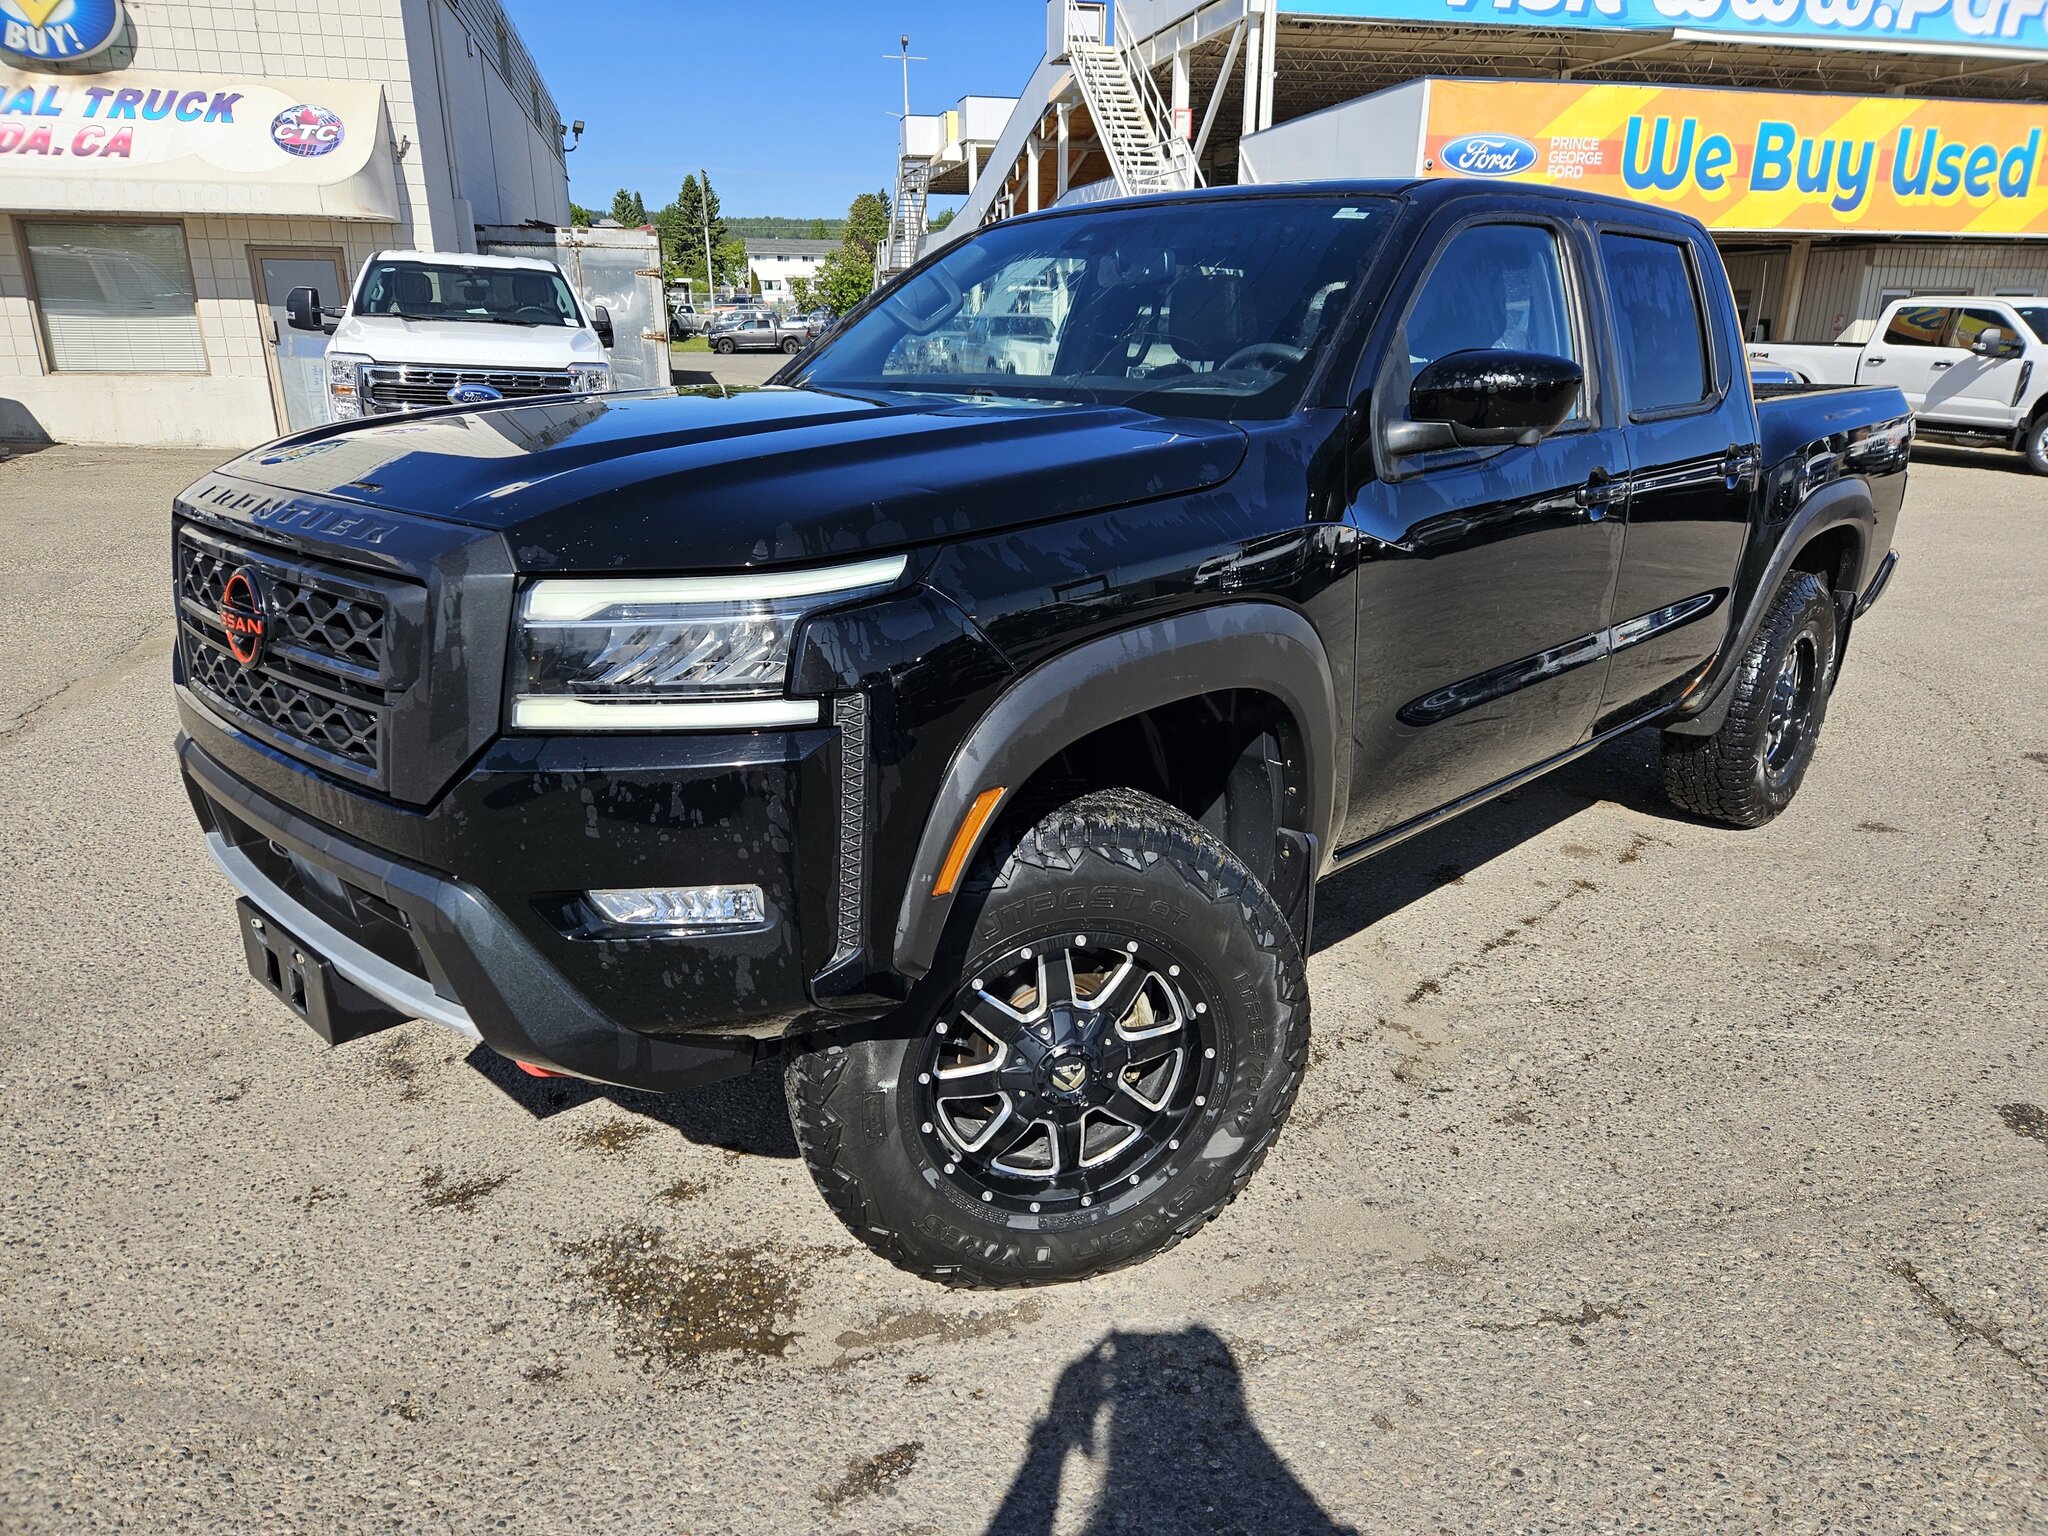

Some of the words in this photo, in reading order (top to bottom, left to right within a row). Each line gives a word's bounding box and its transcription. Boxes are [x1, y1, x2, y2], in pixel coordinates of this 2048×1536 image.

[4, 19, 85, 55] BUY!
[83, 87, 244, 123] TRUCK
[273, 123, 340, 144] CTC
[1550, 136, 1600, 150] PRINCE
[1458, 139, 1520, 170] Ford
[1548, 151, 1603, 164] GEORGE
[1619, 115, 1730, 192] We
[1748, 120, 1876, 211] Buy
[1891, 126, 2043, 198] Used
[1546, 164, 1584, 178] FORD
[198, 485, 400, 543] FRONTIER
[219, 610, 263, 635] SSAN
[975, 886, 1145, 939] UTPOST
